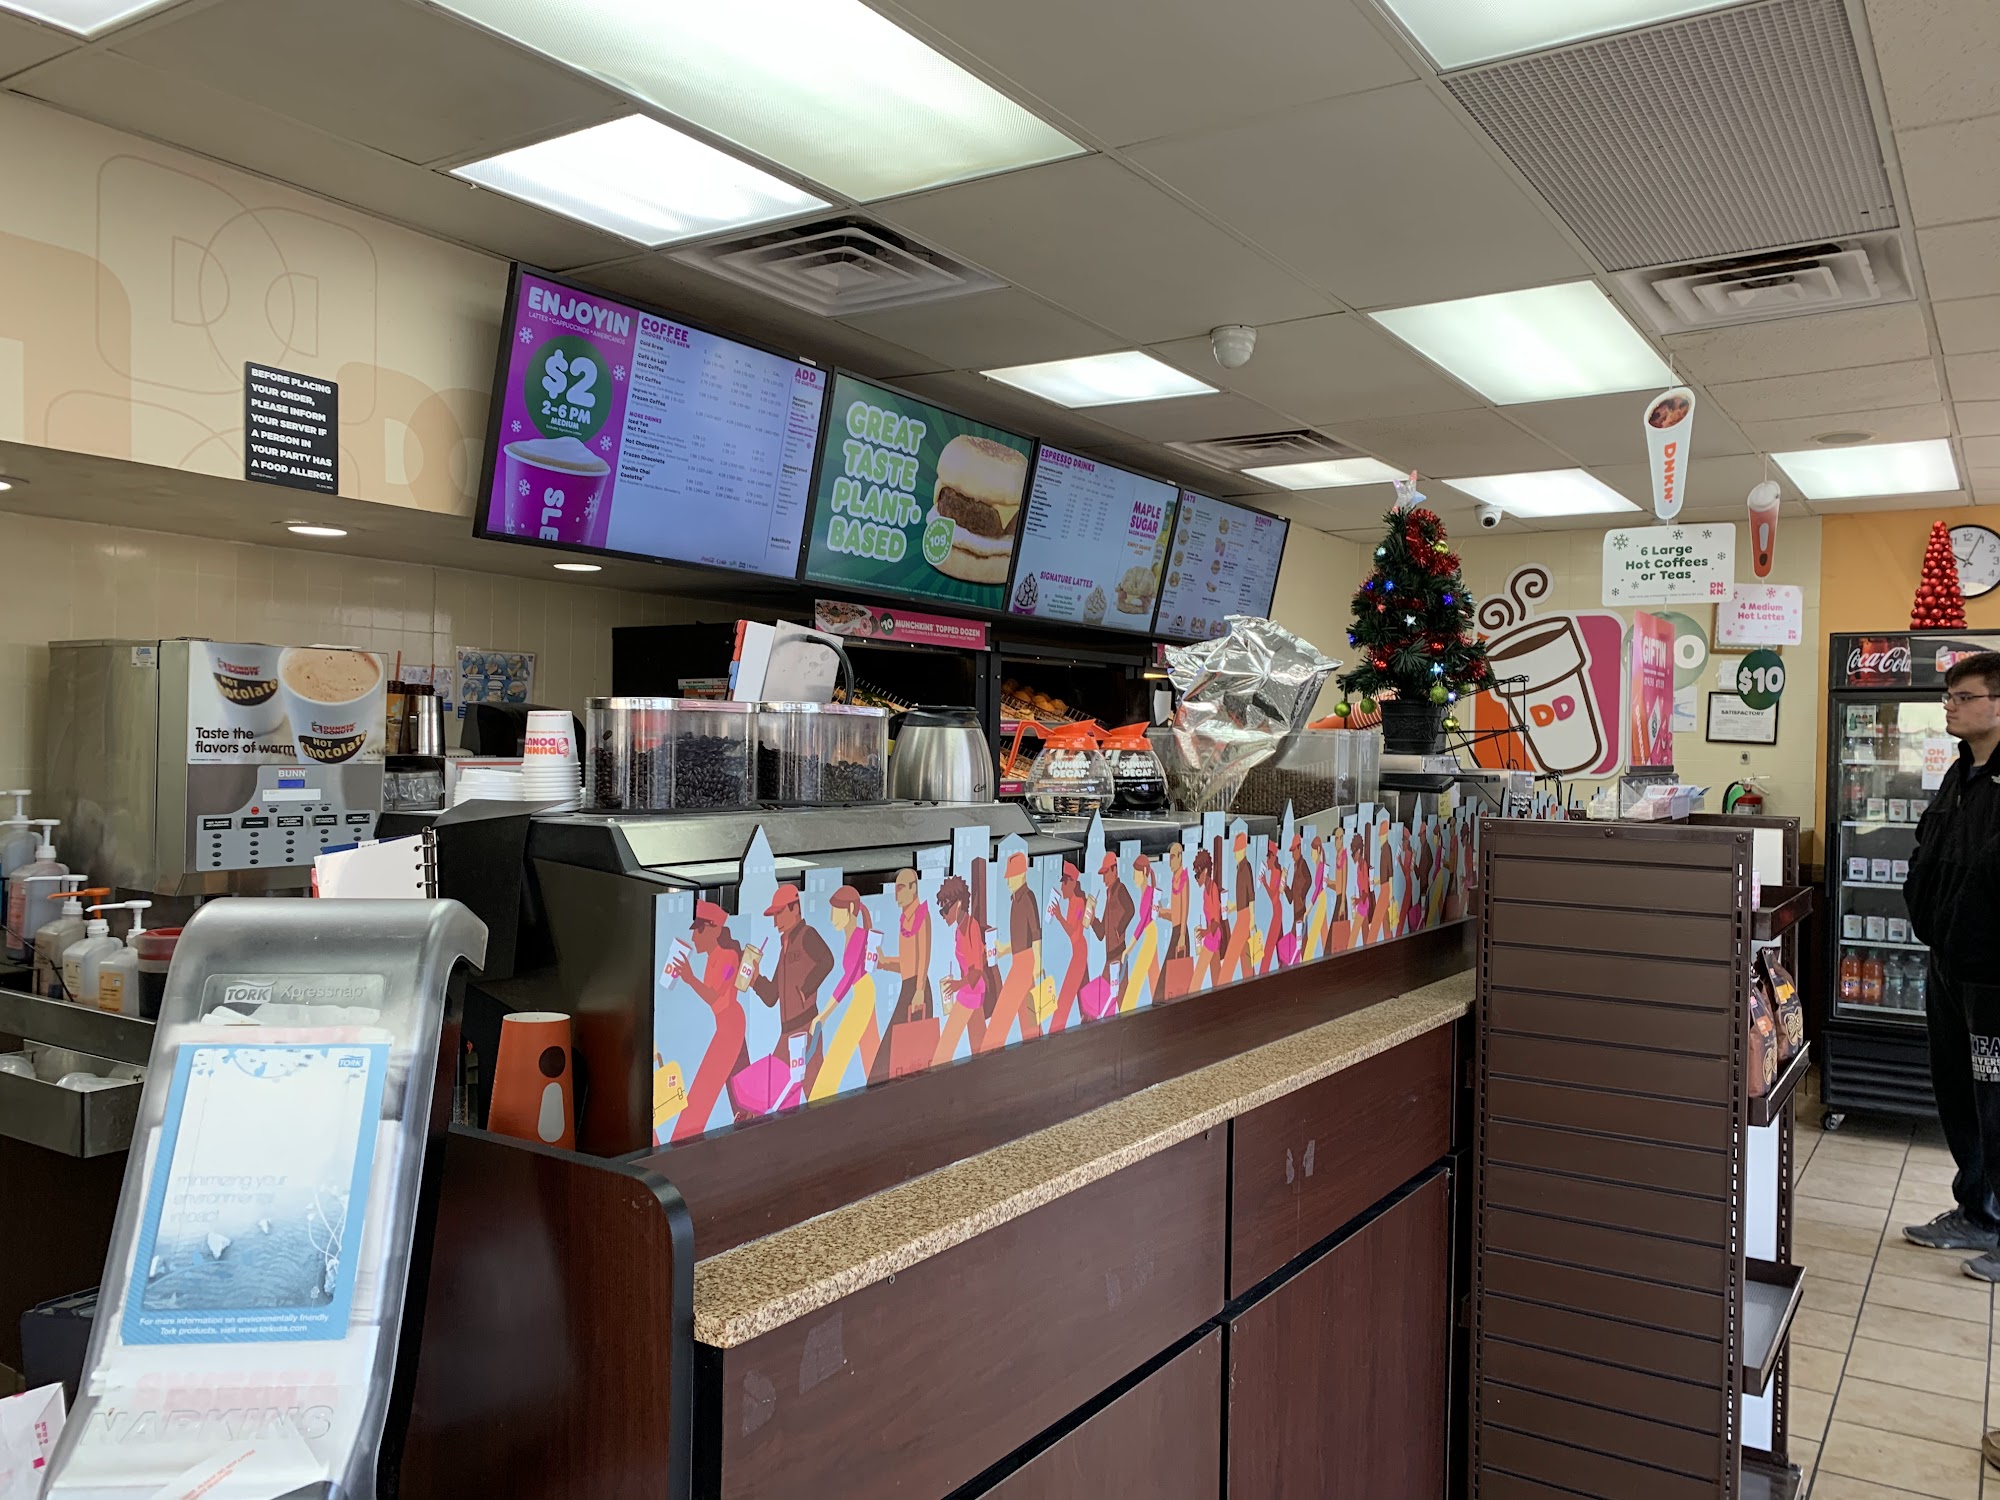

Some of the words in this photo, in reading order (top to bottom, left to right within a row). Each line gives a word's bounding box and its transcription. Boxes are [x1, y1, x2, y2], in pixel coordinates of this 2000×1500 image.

[528, 286, 630, 337] ENJOYIN
[528, 311, 549, 323] LATTES
[640, 317, 689, 345] COFFEE
[639, 340, 652, 348] Cold
[652, 343, 664, 351] Brew
[640, 330, 662, 342] CHOOSE
[662, 335, 677, 347] YOUR
[677, 340, 690, 350] BREW
[637, 361, 647, 369] Iced
[648, 363, 665, 374] Coffee
[251, 368, 290, 385] BEFORE
[291, 378, 331, 394] PLACING
[541, 349, 598, 408] $2
[634, 374, 643, 382] Hot
[644, 376, 663, 386] Coffee
[795, 368, 816, 383] ADD
[251, 383, 279, 397] YOUR
[280, 390, 316, 406] ORDER,
[632, 393, 649, 403] Frozen
[649, 397, 667, 407] Coffee
[251, 398, 289, 414] PLEASE
[290, 407, 326, 422] INFORM
[541, 400, 568, 419] 2-6
[569, 408, 591, 425] PM
[251, 413, 279, 427] YOUR
[280, 419, 317, 435] SERVER
[318, 428, 328, 436] IF
[550, 417, 580, 432] MEDIUM
[628, 418, 638, 426] Iced
[639, 420, 648, 428] Tea
[630, 411, 646, 420] MORE
[645, 415, 662, 425] DRINKS
[627, 425, 637, 433] Hot
[637, 427, 646, 435] Tea
[848, 402, 926, 455] GREAT
[250, 429, 260, 438] A
[261, 431, 300, 446] PERSON
[301, 439, 312, 448] IN
[625, 437, 636, 446] Hot
[636, 440, 660, 452] Chocolate
[251, 444, 279, 457] YOUR
[280, 450, 312, 463] PARTY
[312, 456, 332, 467] HAS
[623, 451, 641, 461] Frozen
[641, 455, 665, 466] Chocolate
[1041, 448, 1073, 467] ESPRESSO
[1073, 457, 1095, 472] DRINKS
[250, 459, 260, 468] A
[261, 460, 289, 473] FOOD
[290, 466, 333, 482] ALLERGY.
[622, 464, 640, 474] Vanilla
[843, 440, 920, 492] TASTE
[1132, 500, 1162, 520] MAPLE
[1130, 514, 1160, 534] SUGAR
[828, 516, 907, 562] BASED
[1963, 532, 1973, 542] 12
[1640, 546, 1648, 556] 6
[1652, 544, 1693, 559] Large
[1990, 544, 1996, 553] 2
[1626, 560, 1651, 570] Hot
[1654, 557, 1708, 568] Coffees
[1993, 556, 2000, 566] 3
[1040, 571, 1073, 585] SIGNATURE
[1072, 578, 1094, 588] LATTES
[1640, 570, 1656, 581] or
[1659, 570, 1692, 580] Teas
[1748, 602, 1784, 612] Medium
[1738, 612, 1754, 620] Hot
[1756, 612, 1785, 621] Lattes
[880, 618, 894, 631] $10
[936, 624, 960, 635] TOPPED
[960, 628, 981, 638] DOZEN
[1847, 647, 1911, 675] Coca-Cola
[220, 676, 238, 688] HOT
[1738, 666, 1784, 695] $10
[1530, 695, 1575, 728] DD
[196, 728, 230, 742] Taste
[232, 727, 254, 742] the
[195, 740, 239, 755] flavors
[242, 740, 256, 755] of
[258, 744, 295, 756] warm
[314, 738, 332, 748] HOT
[866, 950, 878, 962] DD
[988, 948, 997, 958] DD
[742, 966, 752, 976] DD
[227, 986, 270, 1001] TORK
[280, 985, 363, 1001] Xpressnap
[340, 1057, 363, 1068] TORK
[792, 1057, 805, 1069] DD
[138, 1318, 151, 1326] For
[176, 1316, 224, 1326] information
[237, 1314, 298, 1325] environmentally
[299, 1313, 329, 1323] friendly
[160, 1327, 177, 1335] Tork
[220, 1326, 236, 1334] visit
[238, 1324, 308, 1334] www.torkusa.com
[80, 1405, 334, 1446] NAPKINS
